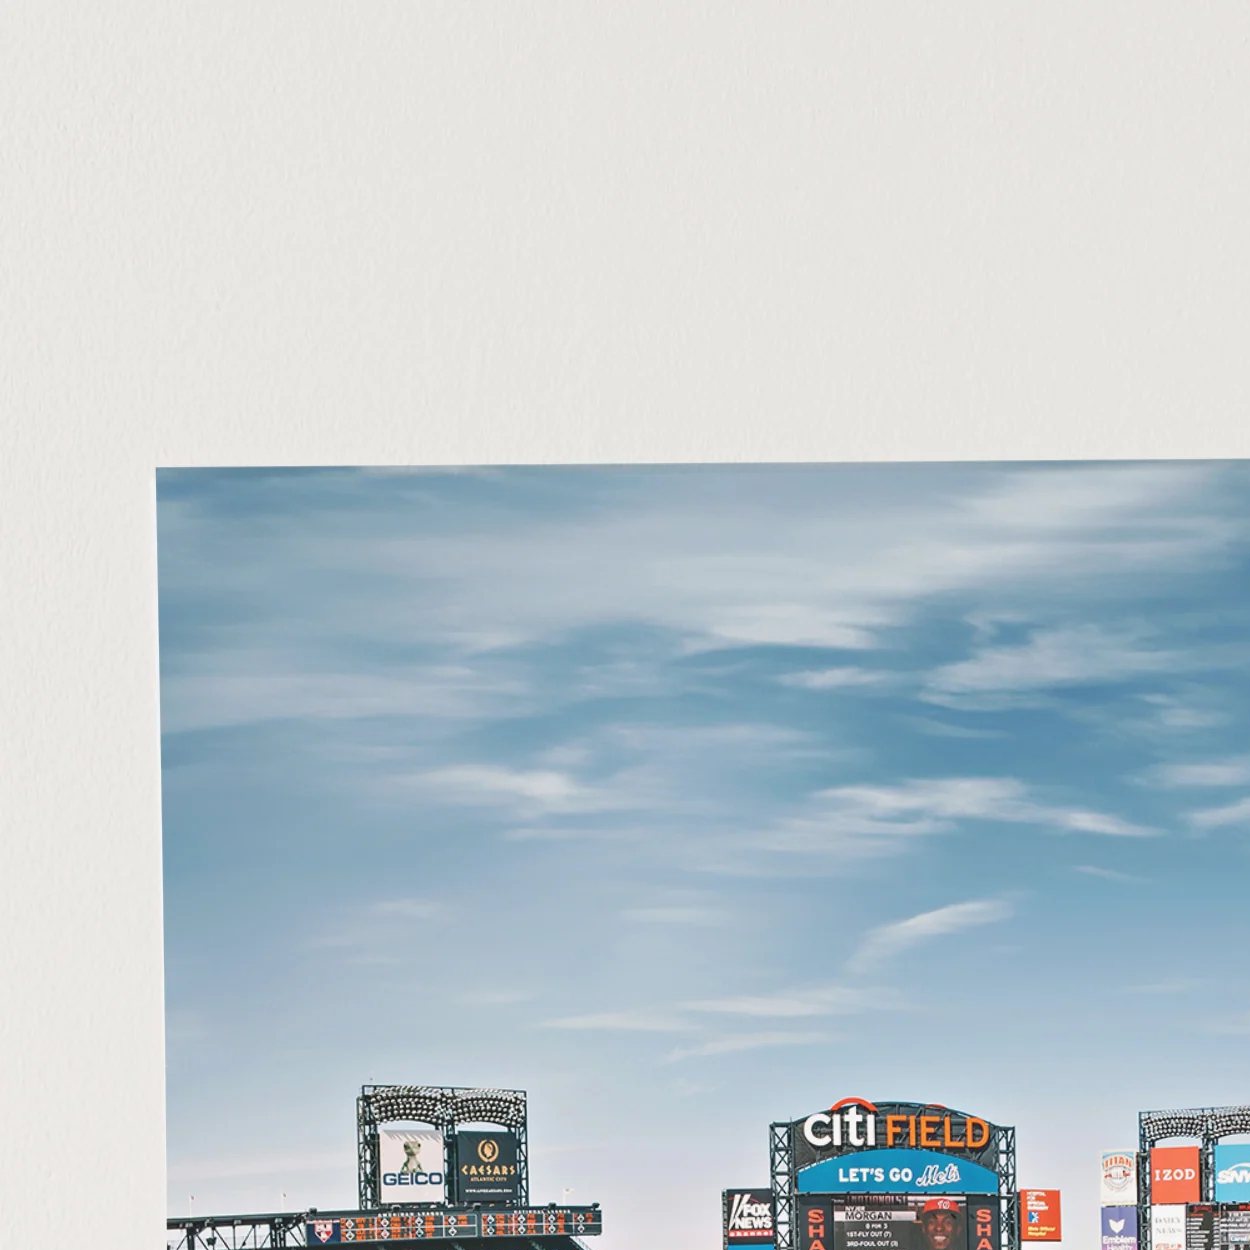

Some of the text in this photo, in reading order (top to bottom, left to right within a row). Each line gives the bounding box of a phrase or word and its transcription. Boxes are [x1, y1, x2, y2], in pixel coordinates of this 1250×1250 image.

[803, 1104, 989, 1148] citi FIELD
[461, 1165, 516, 1175] CAESARS
[838, 1163, 962, 1187] LET'S GO Mets
[1154, 1168, 1196, 1181] IZOD
[383, 1172, 443, 1186] GEICO
[742, 1203, 772, 1217] FOX
[844, 1211, 893, 1220] MORGAN
[734, 1216, 773, 1230] NEWS
[1102, 1236, 1137, 1245] Emblem
